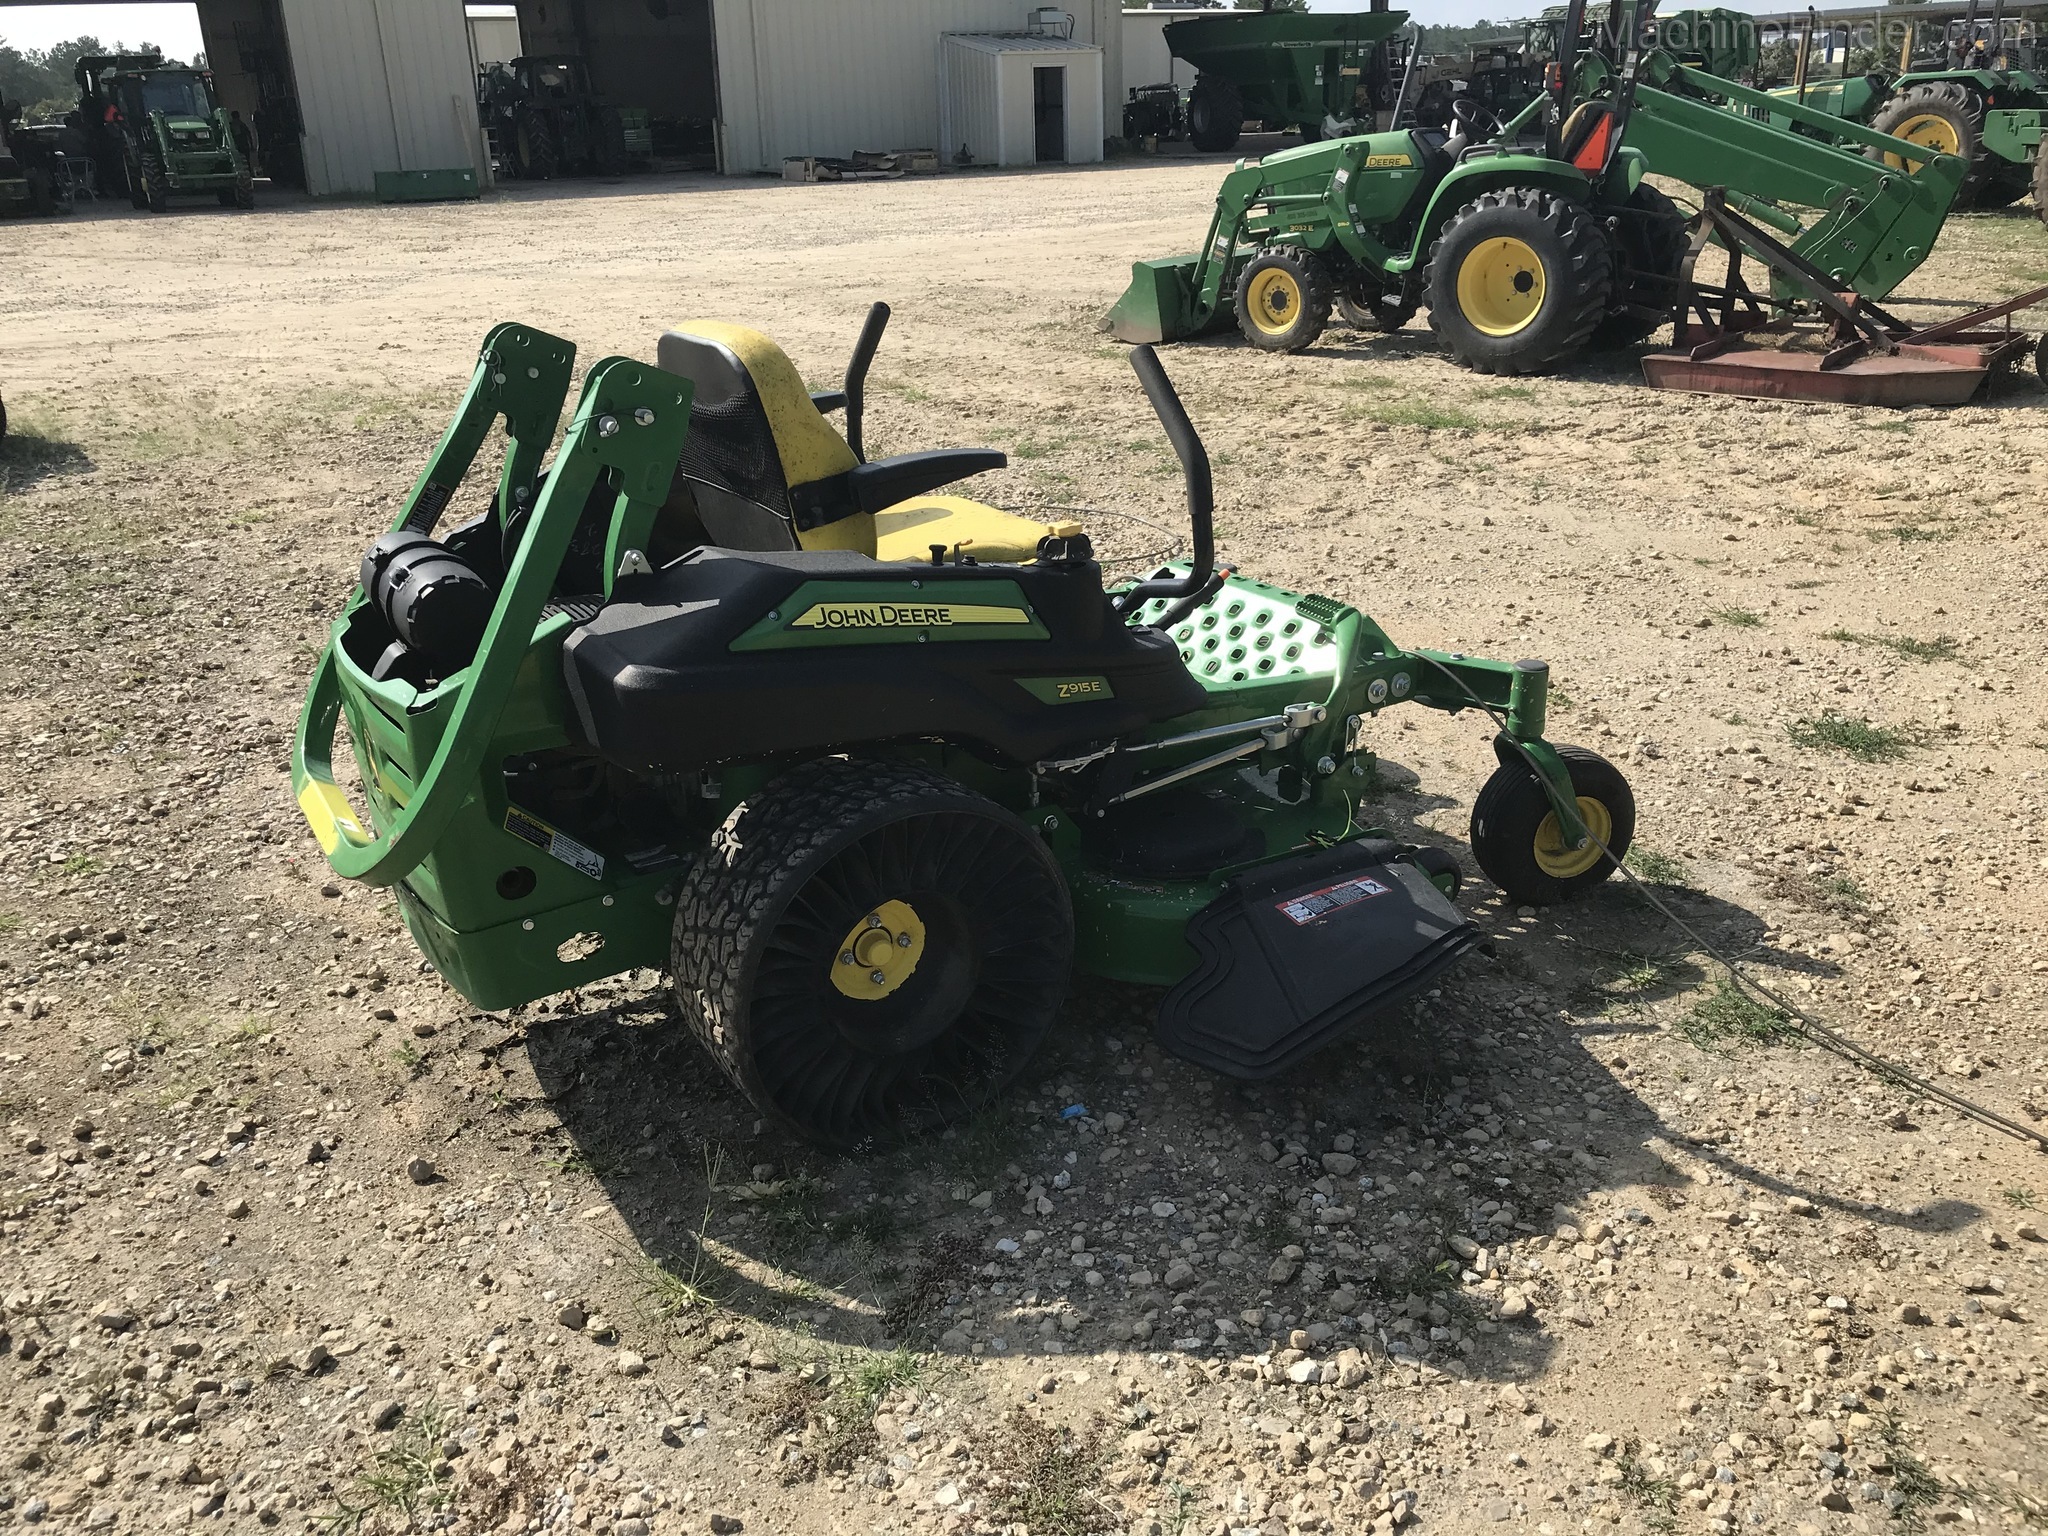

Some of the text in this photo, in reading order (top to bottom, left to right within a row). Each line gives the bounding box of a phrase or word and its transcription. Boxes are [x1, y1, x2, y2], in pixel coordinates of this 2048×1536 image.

[1369, 157, 1402, 167] DEERE
[815, 605, 953, 627] JOHN DEERE
[1056, 681, 1102, 698] Z915E
